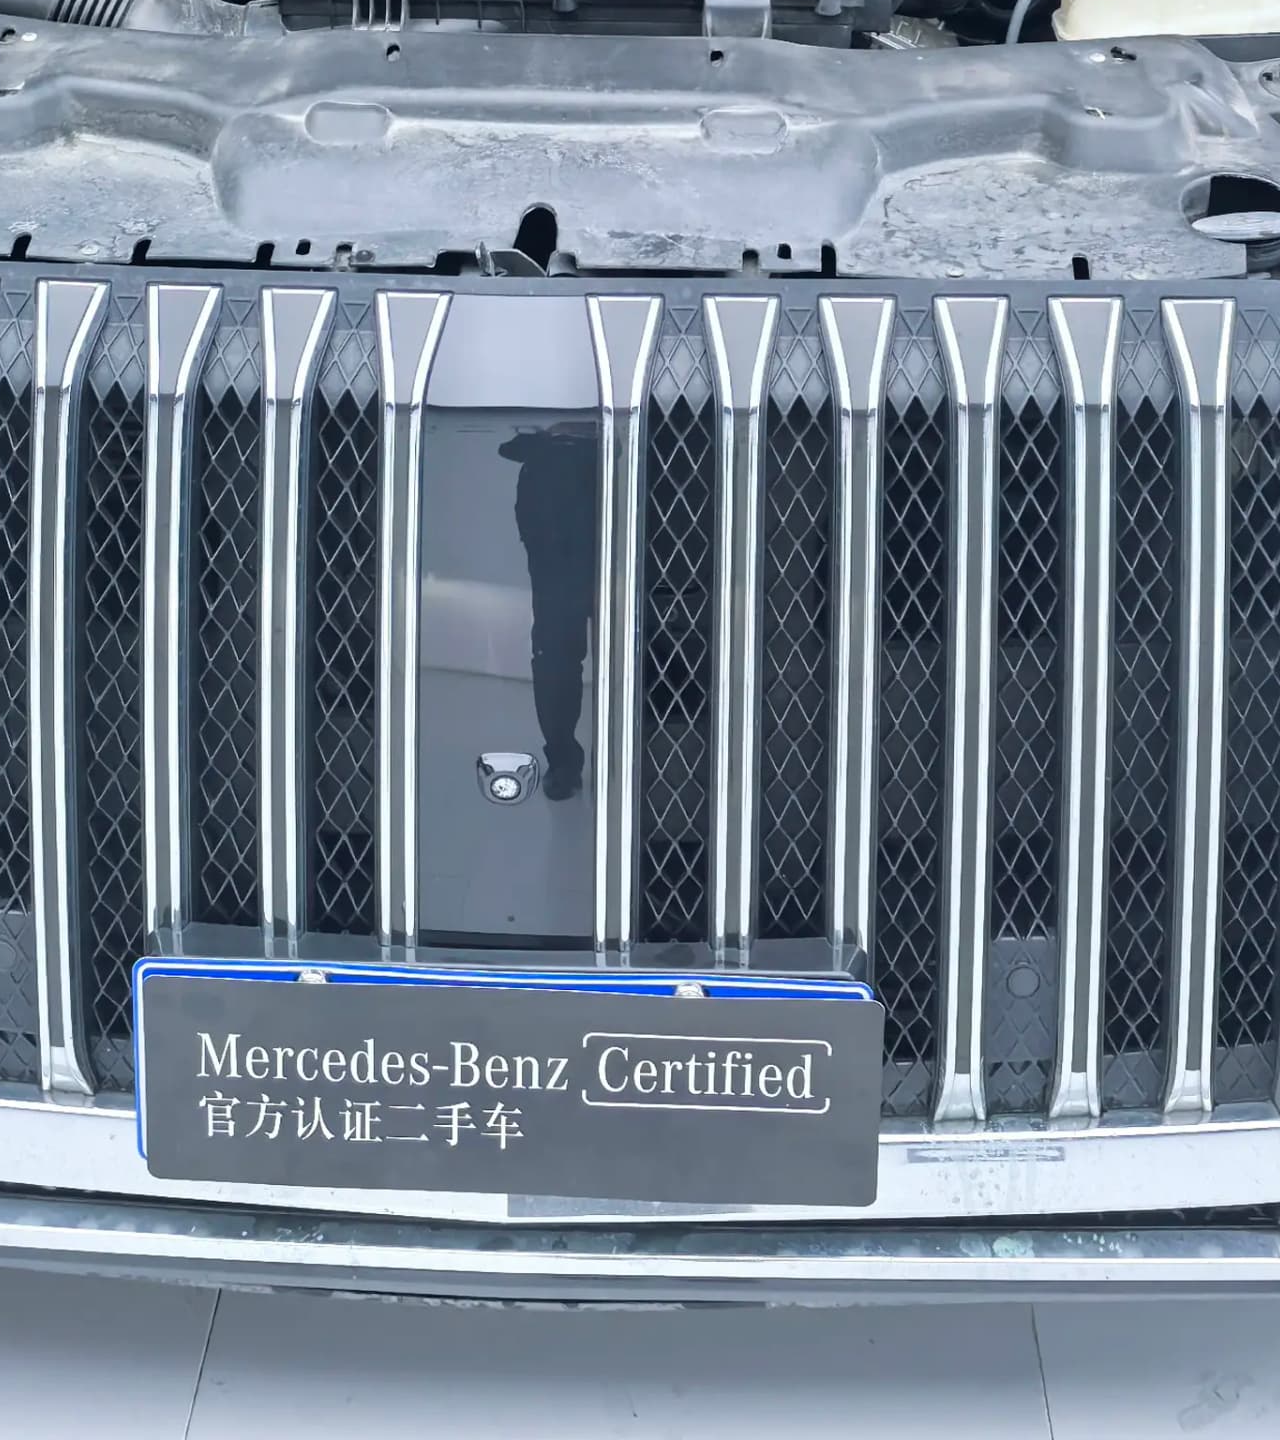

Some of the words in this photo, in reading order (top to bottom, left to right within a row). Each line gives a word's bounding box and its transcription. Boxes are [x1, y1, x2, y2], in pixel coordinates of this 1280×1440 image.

[196, 1032, 569, 1091] Mercedes-Benz
[598, 1046, 815, 1099] Certified
[198, 1089, 524, 1150] 官方认证二手车
